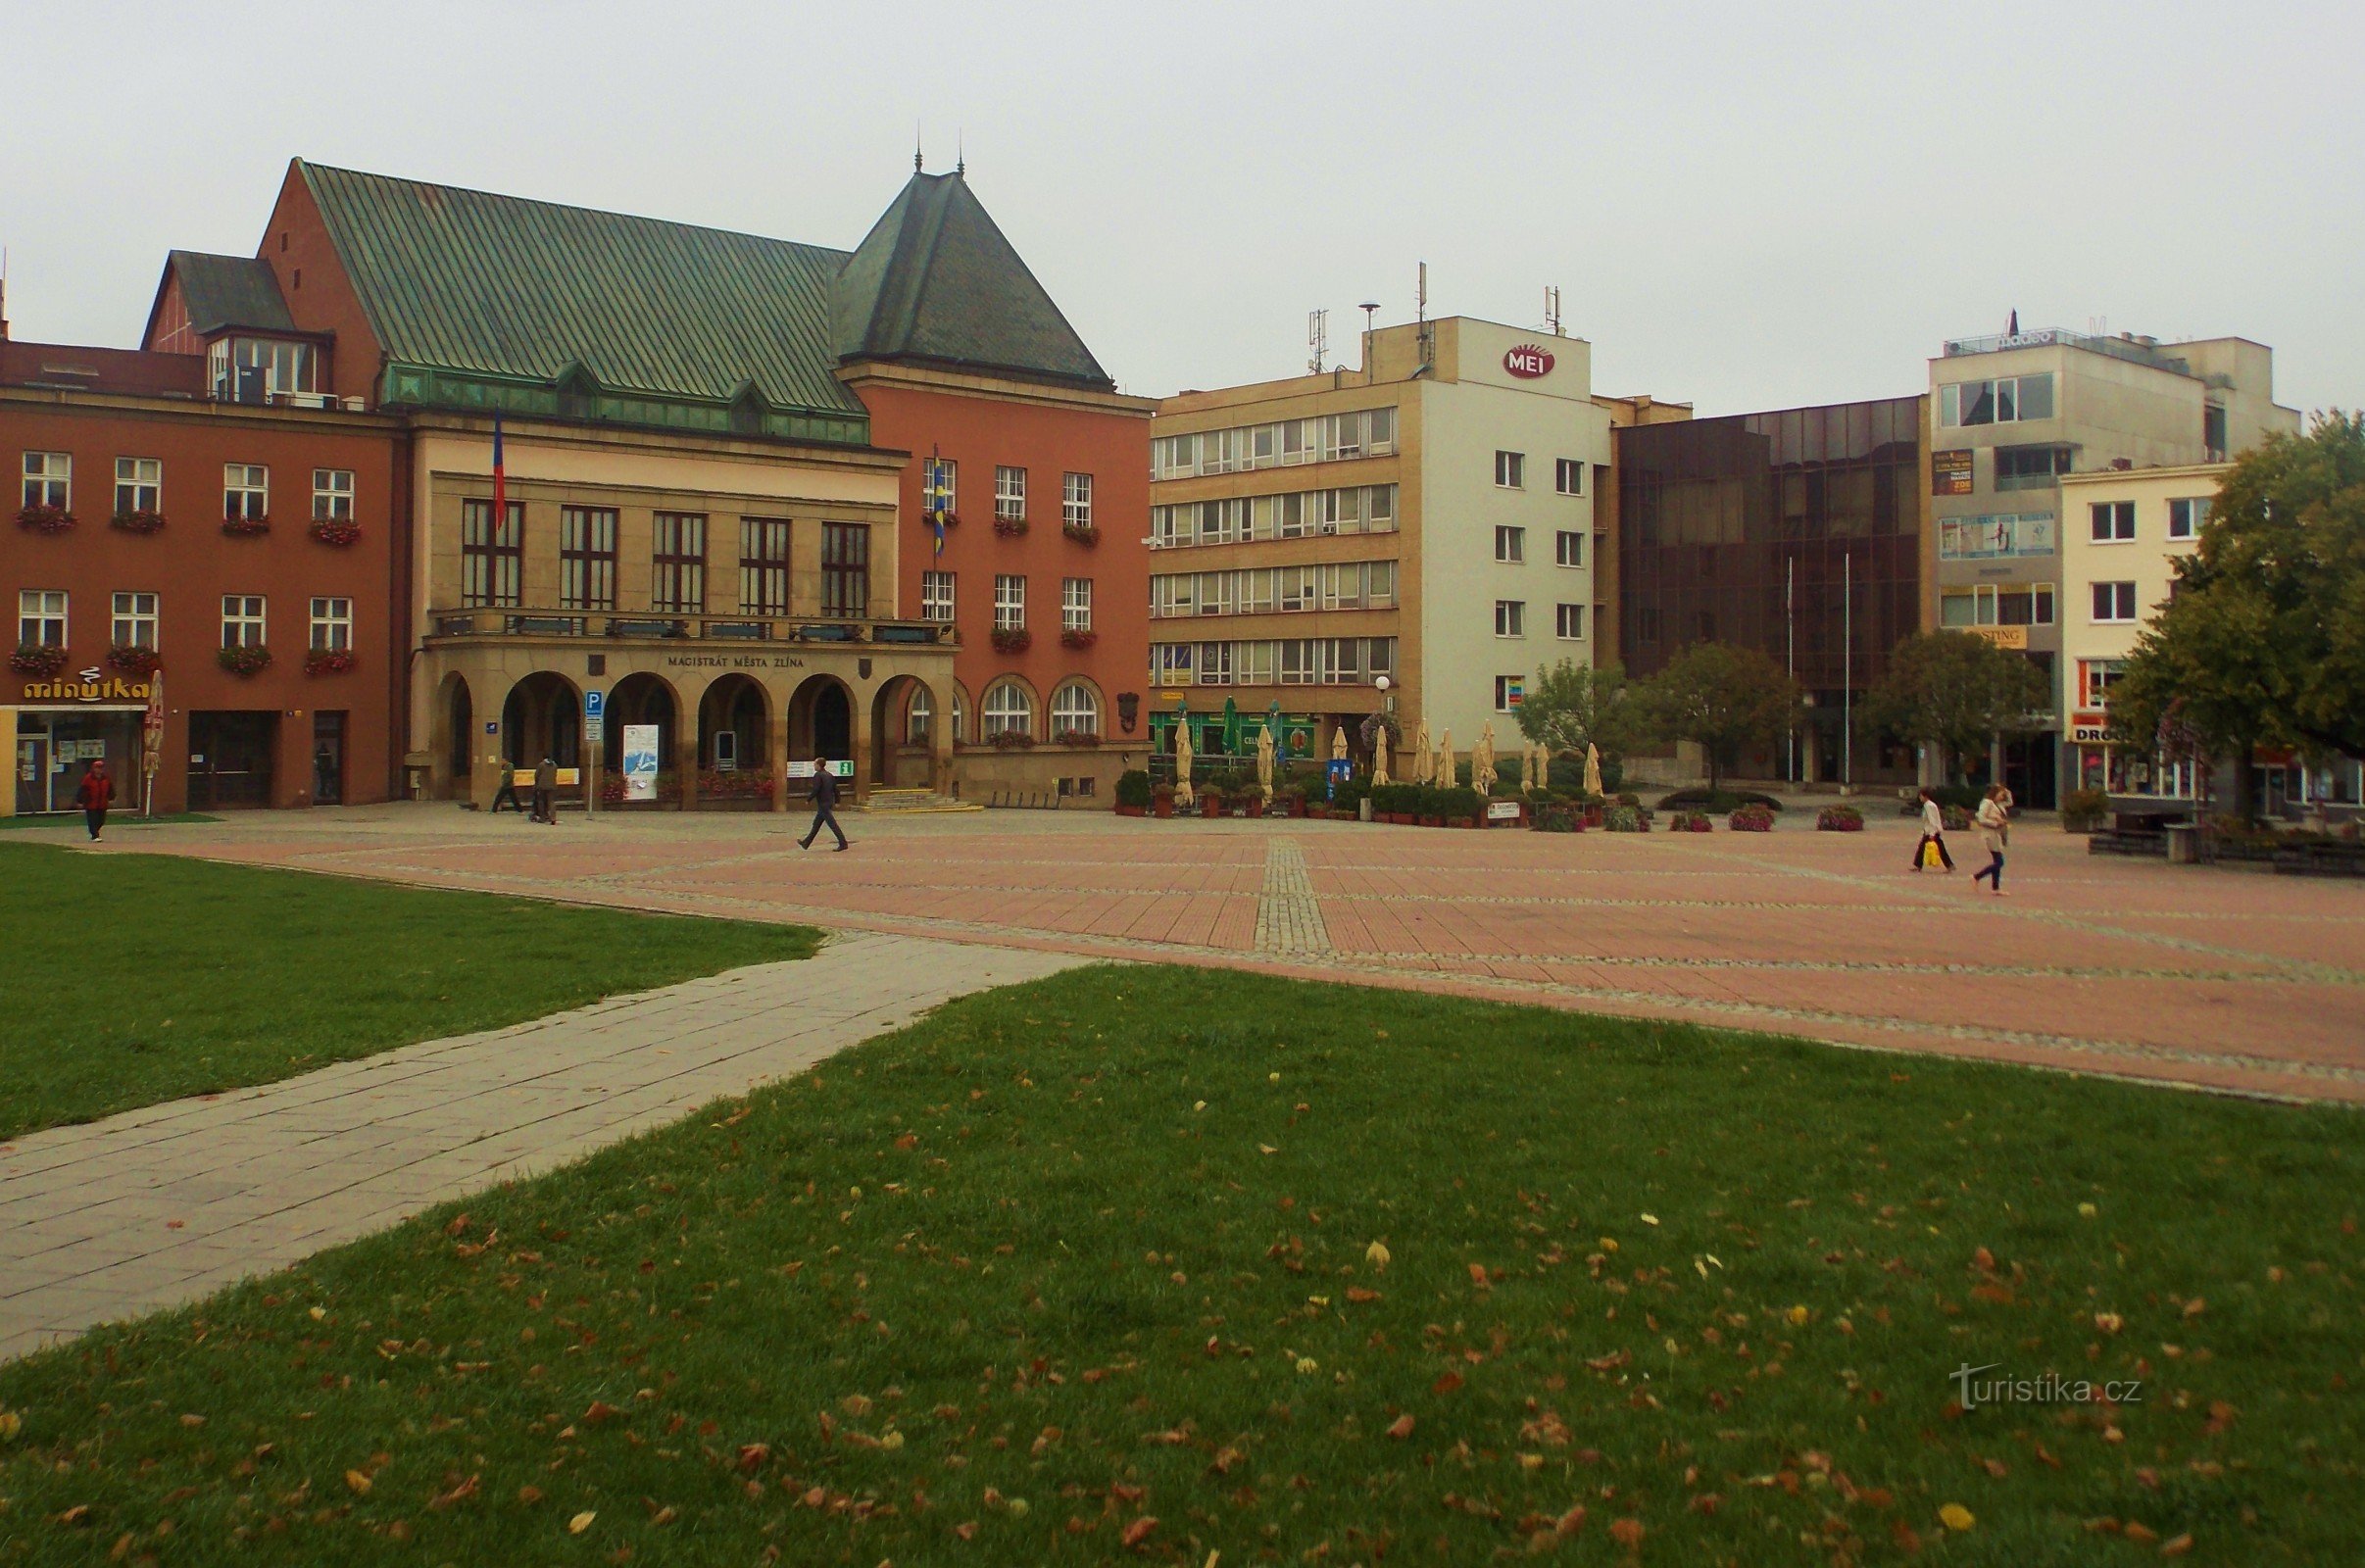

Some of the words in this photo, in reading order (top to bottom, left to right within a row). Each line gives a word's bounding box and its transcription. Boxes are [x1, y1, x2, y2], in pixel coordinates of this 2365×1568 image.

[1508, 352, 1544, 373] MEI
[1977, 629, 2019, 640] STING
[667, 655, 728, 667] MAGISTRÁT
[734, 656, 767, 667] MĚSTA
[773, 656, 804, 667] ZLÍNA
[24, 677, 151, 699] minutka
[588, 693, 600, 709] P
[2076, 729, 2117, 741] DRO
